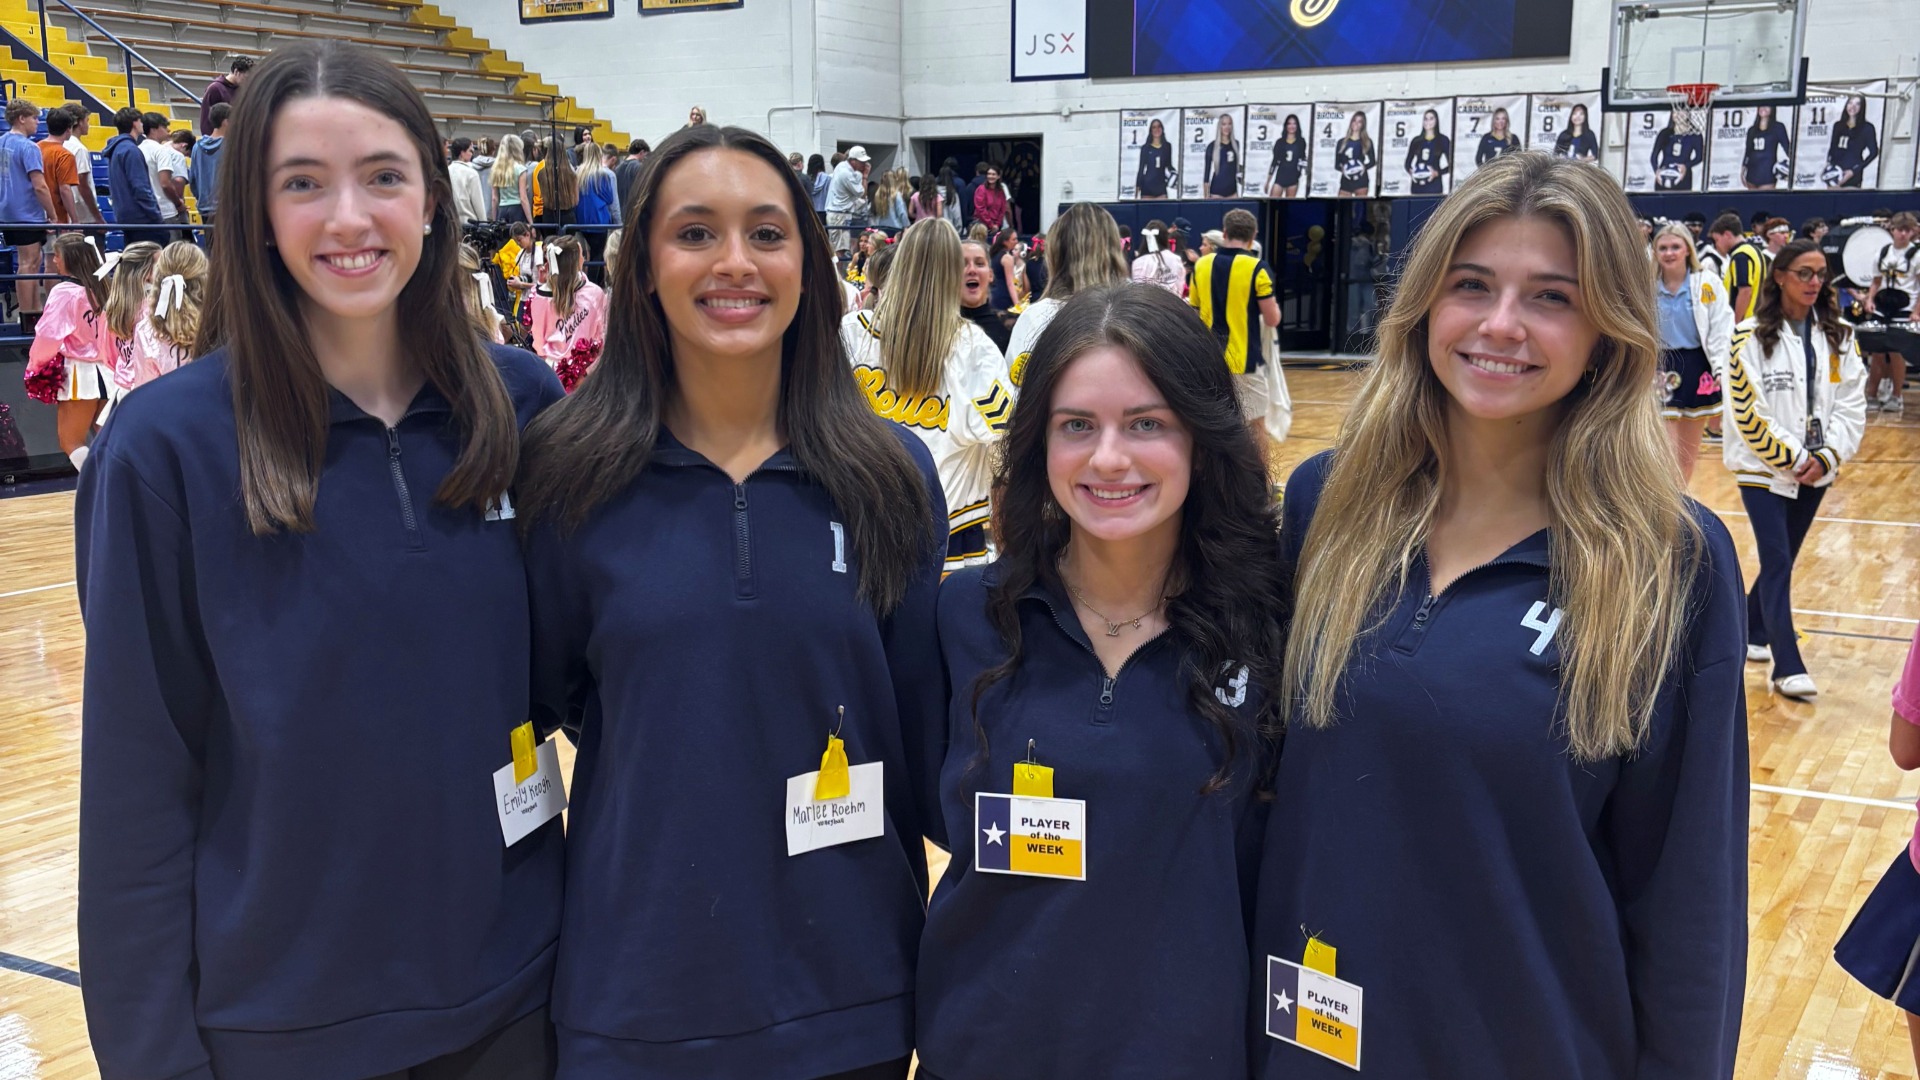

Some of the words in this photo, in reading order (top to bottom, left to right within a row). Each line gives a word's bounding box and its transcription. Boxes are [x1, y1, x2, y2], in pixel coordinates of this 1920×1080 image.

[1025, 32, 1075, 56] JSX
[1543, 115, 1553, 132] 8
[1643, 113, 1655, 130] 9
[1723, 110, 1743, 128] 10
[1810, 107, 1826, 125] 11
[1257, 125, 1267, 141] 3
[1323, 122, 1332, 138] 4
[1396, 121, 1405, 138] 6
[1470, 117, 1480, 133] 7
[1132, 129, 1138, 144] 1
[1194, 128, 1204, 143] 2
[830, 521, 847, 574] 1
[1520, 600, 1565, 656] 4
[1215, 659, 1250, 708] 3
[503, 786, 527, 816] Emily
[528, 775, 552, 801] Keogh
[793, 803, 827, 825] Marlee
[831, 801, 866, 818] Roehm
[1021, 817, 1070, 830] PLAYER
[1030, 831, 1041, 840] of
[1044, 832, 1061, 842] the
[1027, 843, 1064, 855] WEEK
[1307, 990, 1349, 1015] PLAYER
[1314, 1007, 1324, 1017] of
[1326, 1010, 1340, 1023] the
[1311, 1017, 1343, 1039] WEEK
